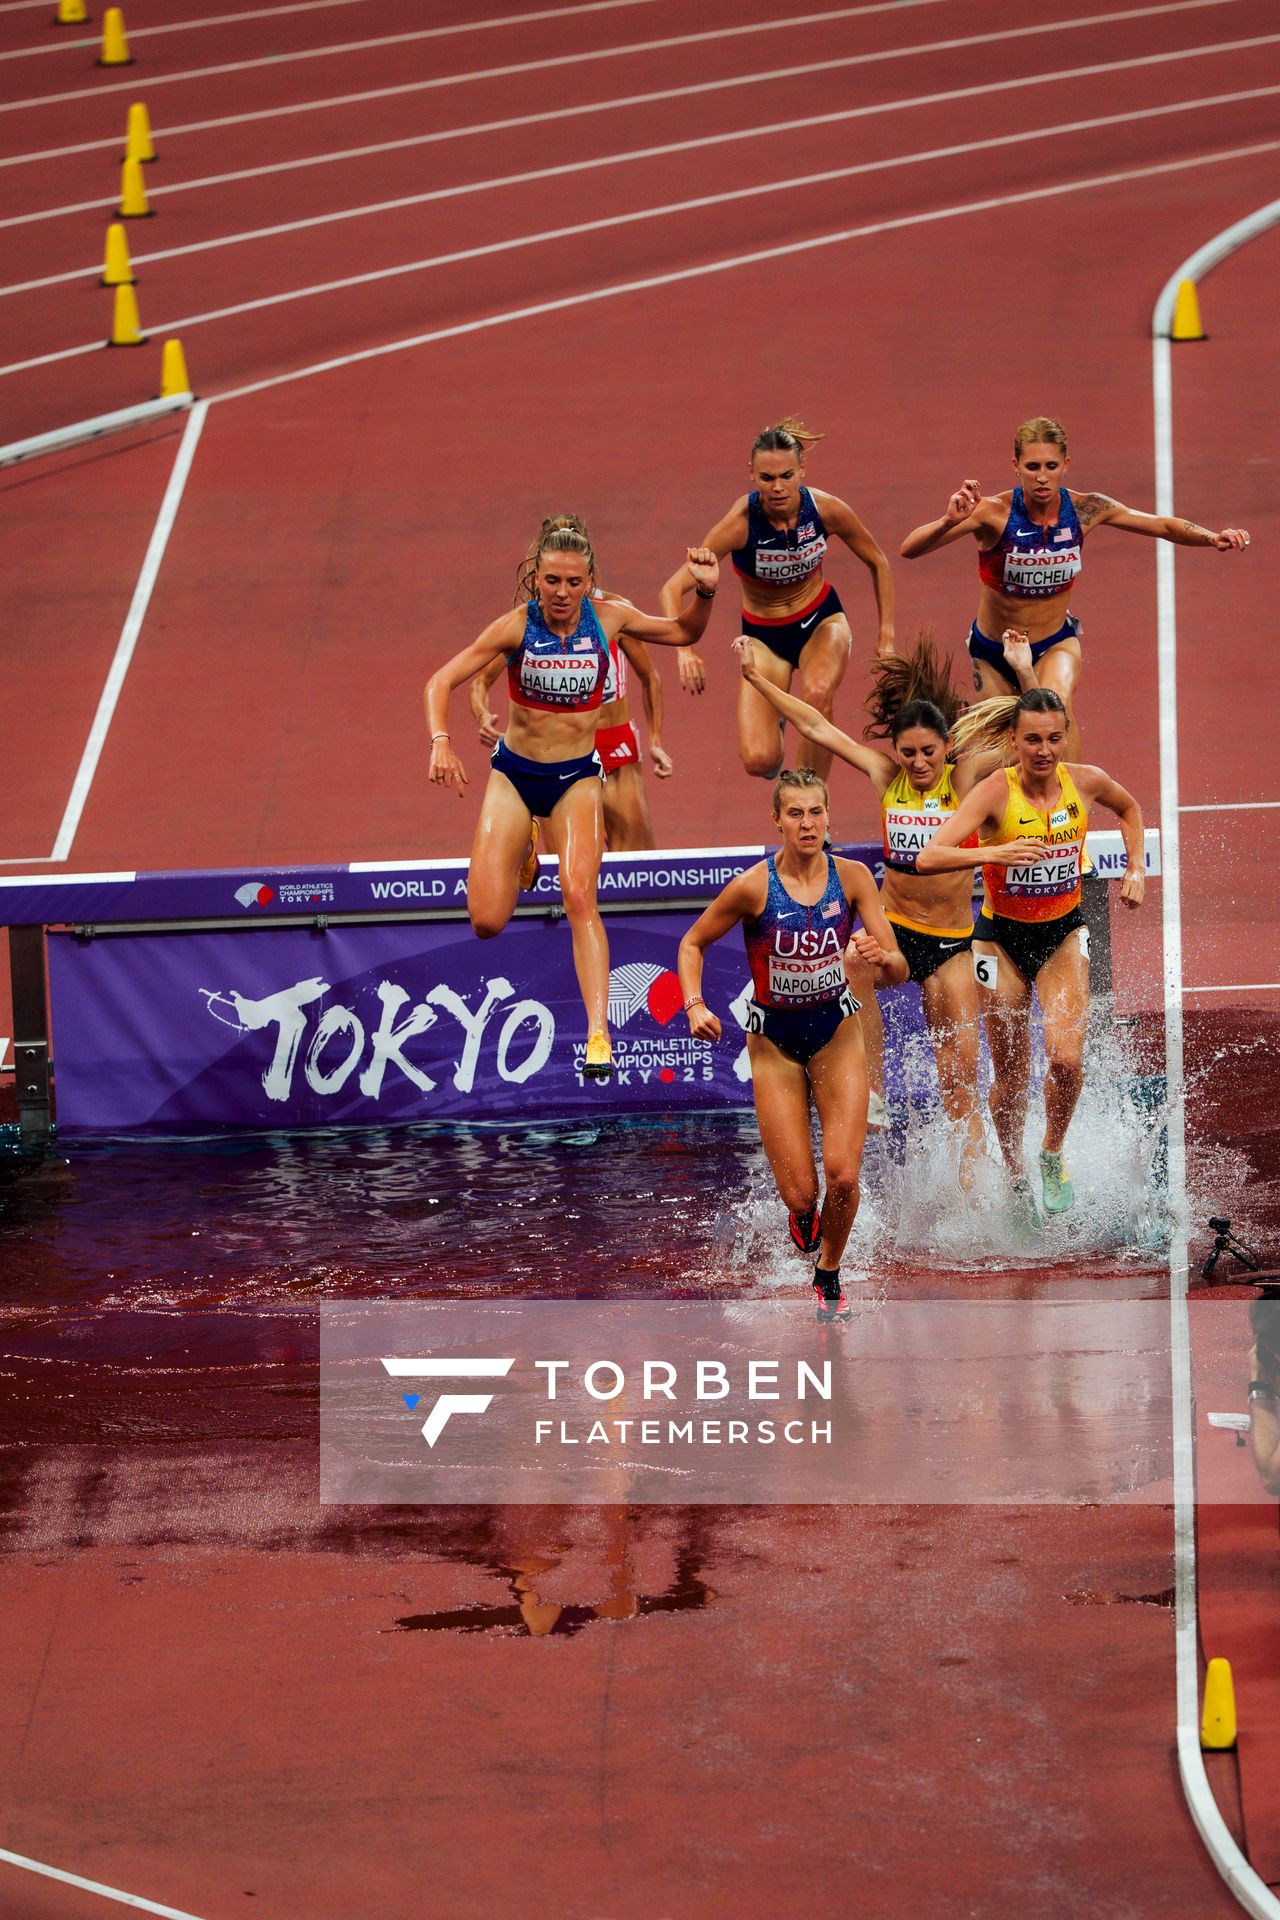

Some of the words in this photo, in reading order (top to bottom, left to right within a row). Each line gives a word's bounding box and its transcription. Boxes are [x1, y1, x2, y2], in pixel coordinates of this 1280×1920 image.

[758, 541, 824, 563] HONDA
[1008, 552, 1079, 567] HONDA
[1008, 568, 1074, 585] MITCHELL
[524, 656, 596, 670] HONDA
[524, 672, 594, 693] HALLADAY
[1051, 813, 1067, 824] WGV
[1043, 845, 1079, 860] NDA
[1099, 852, 1151, 870] NISI
[1012, 861, 1076, 883] MEYER
[370, 880, 446, 899] WORLD
[775, 927, 840, 957] USA
[771, 955, 841, 973] HONDA
[976, 960, 989, 983] 6
[773, 967, 842, 994] NAPOLEON
[199, 976, 555, 1102] TOKYO
[631, 1038, 712, 1053] ATHLETICS
[573, 1051, 713, 1071] CMPIONSHIPS
[683, 1067, 714, 1082] 25
